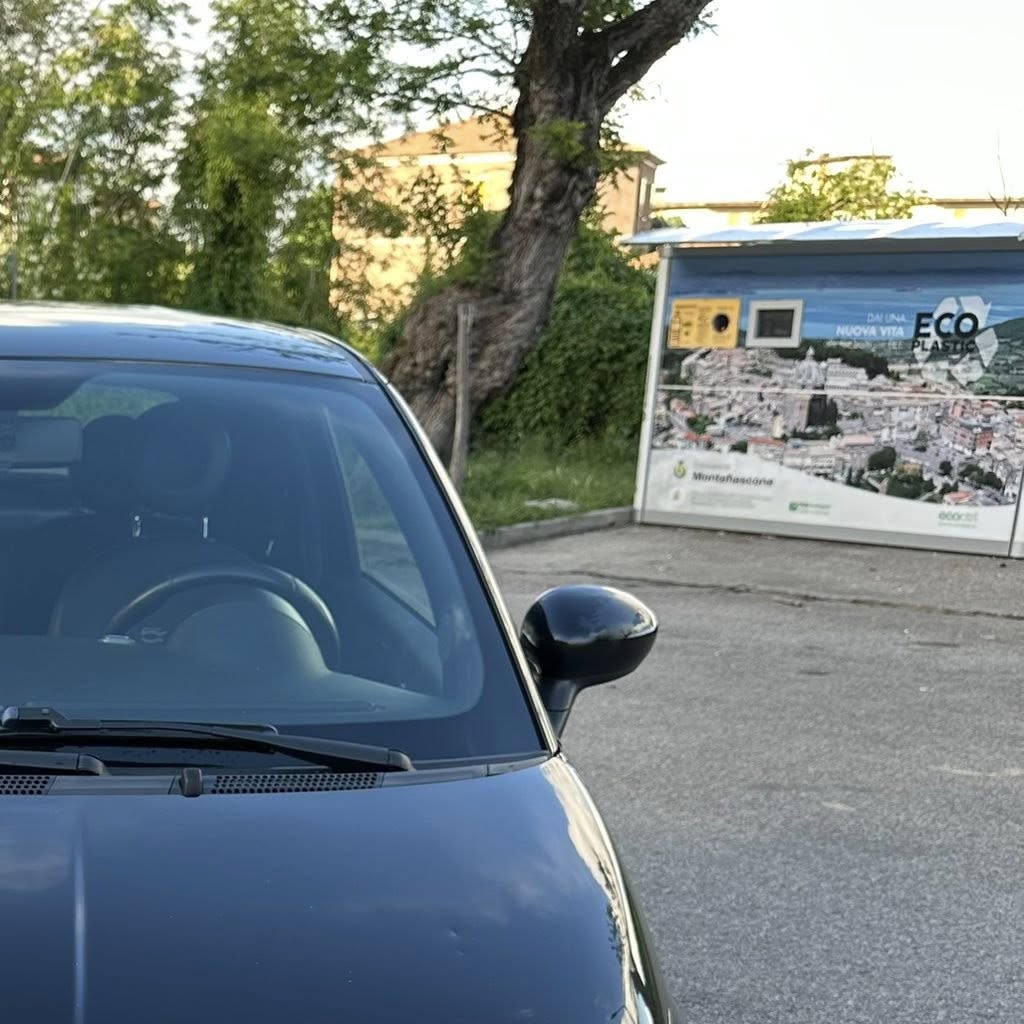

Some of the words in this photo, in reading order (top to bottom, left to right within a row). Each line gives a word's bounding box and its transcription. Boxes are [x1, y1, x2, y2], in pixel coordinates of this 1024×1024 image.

[835, 325, 876, 336] NUOVA
[879, 325, 905, 336] VITA
[914, 312, 979, 339] ECO
[912, 339, 976, 352] PLASTIC
